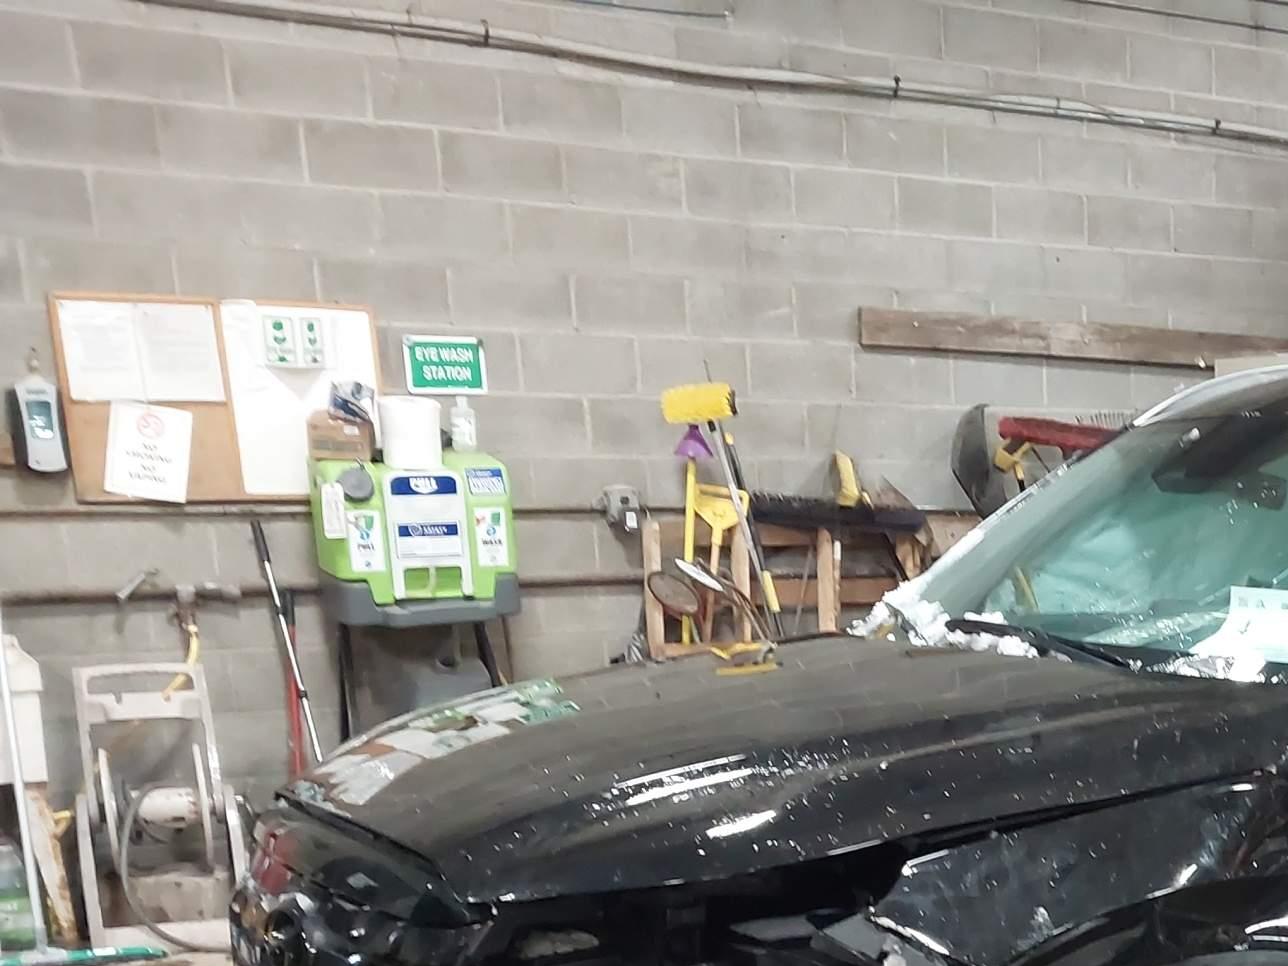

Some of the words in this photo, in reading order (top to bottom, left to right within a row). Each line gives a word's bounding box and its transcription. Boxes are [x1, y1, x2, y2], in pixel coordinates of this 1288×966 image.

[415, 345, 438, 362] EYE
[438, 346, 473, 363] WASH
[422, 364, 472, 382] STATION
